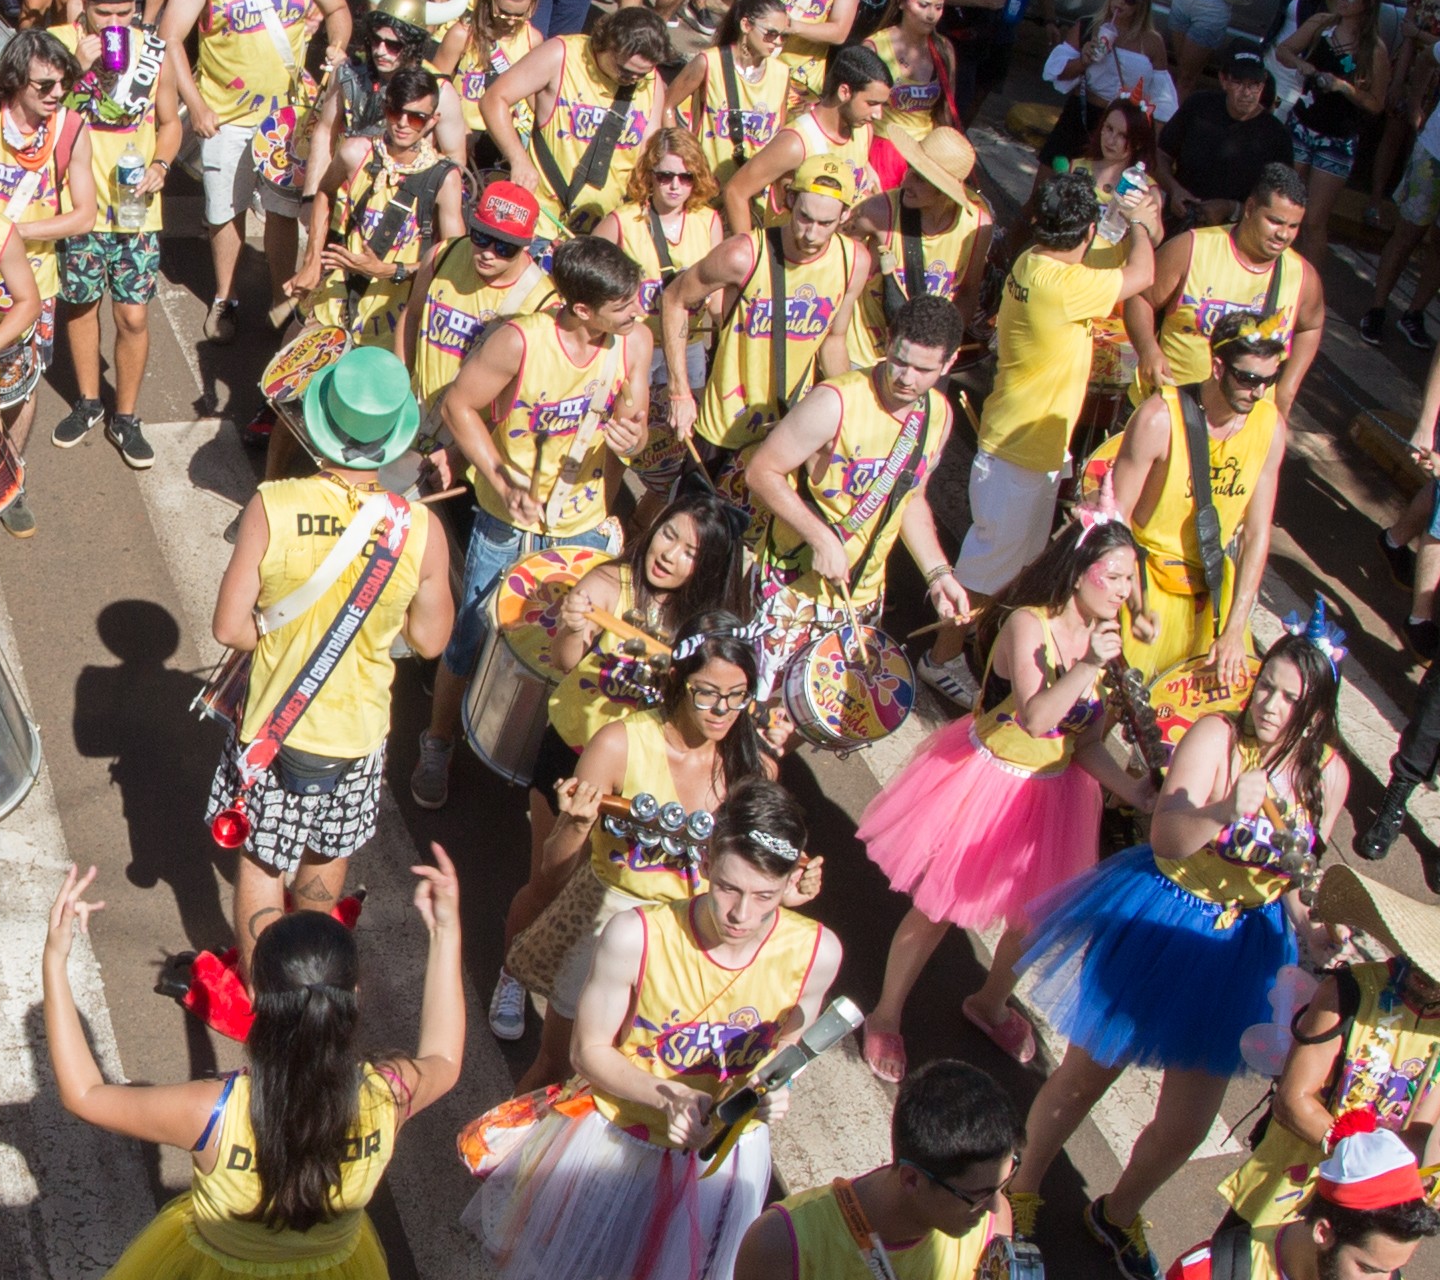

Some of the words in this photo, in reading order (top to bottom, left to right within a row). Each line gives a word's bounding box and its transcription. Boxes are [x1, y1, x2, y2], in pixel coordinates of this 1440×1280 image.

[448, 309, 476, 334] OI
[560, 398, 586, 418] OI
[312, 613, 360, 682] CONTRÁRIO
[816, 685, 869, 737] Sumida
